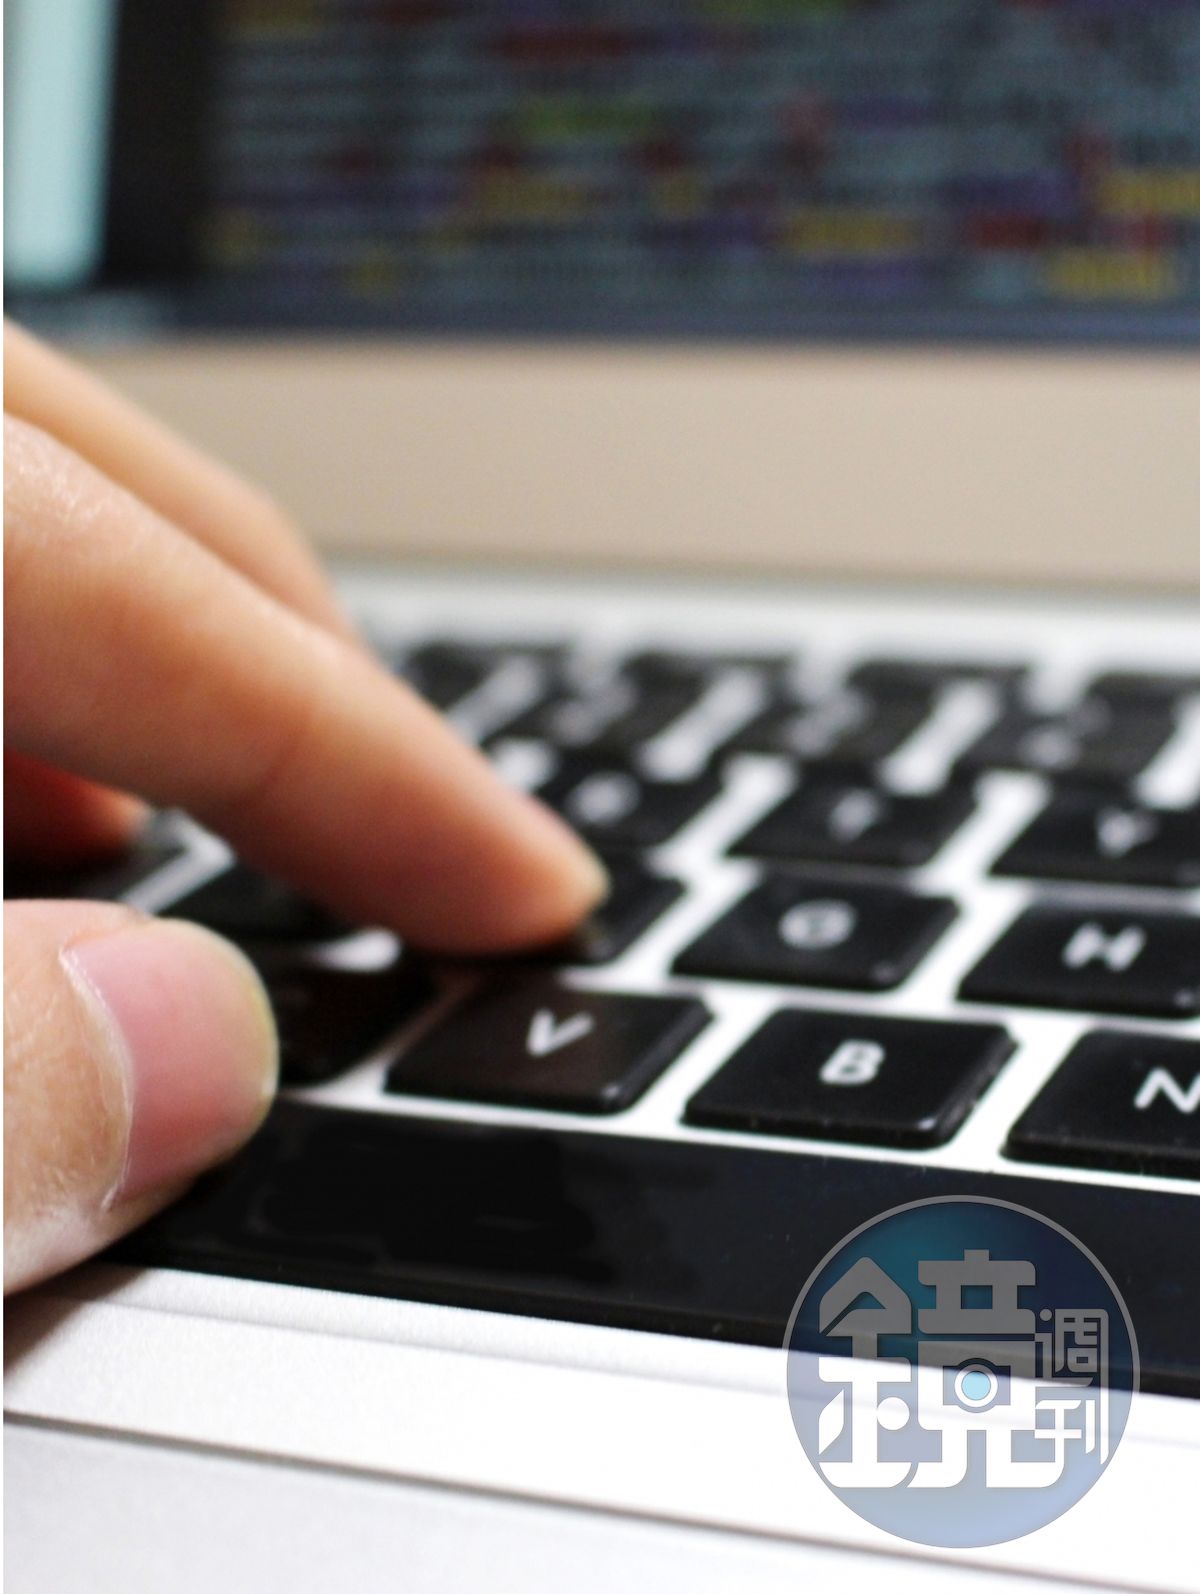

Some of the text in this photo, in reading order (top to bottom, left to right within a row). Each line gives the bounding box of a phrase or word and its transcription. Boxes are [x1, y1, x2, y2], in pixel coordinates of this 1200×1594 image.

[1064, 924, 1145, 971] H
[527, 1010, 595, 1056] V
[820, 1040, 886, 1085] B
[1134, 1068, 1200, 1113] N
